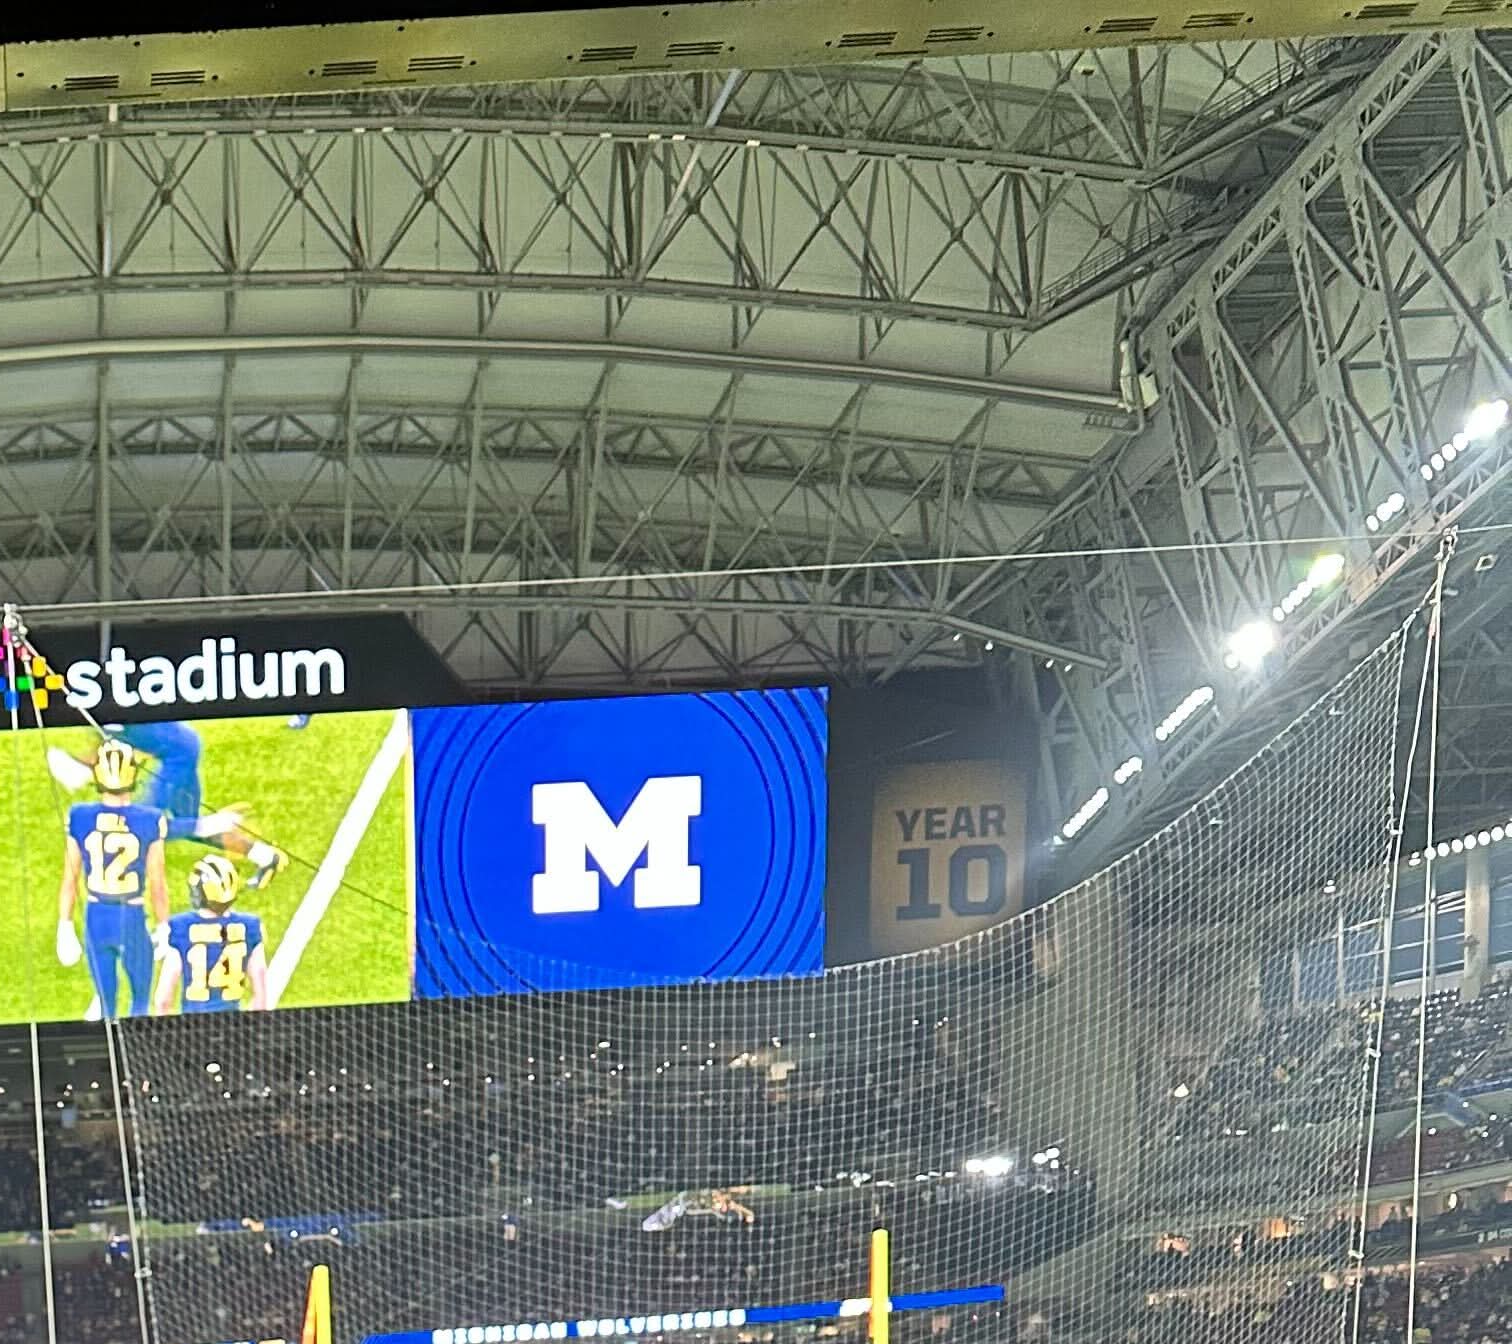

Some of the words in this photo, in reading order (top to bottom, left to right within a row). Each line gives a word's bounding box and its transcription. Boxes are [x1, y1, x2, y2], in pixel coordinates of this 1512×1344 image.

[66, 637, 346, 708] stadium
[532, 775, 702, 914] M
[895, 803, 1006, 842] YEAR
[84, 831, 141, 894] 12
[895, 844, 1008, 921] 10
[185, 942, 248, 1002] 14
